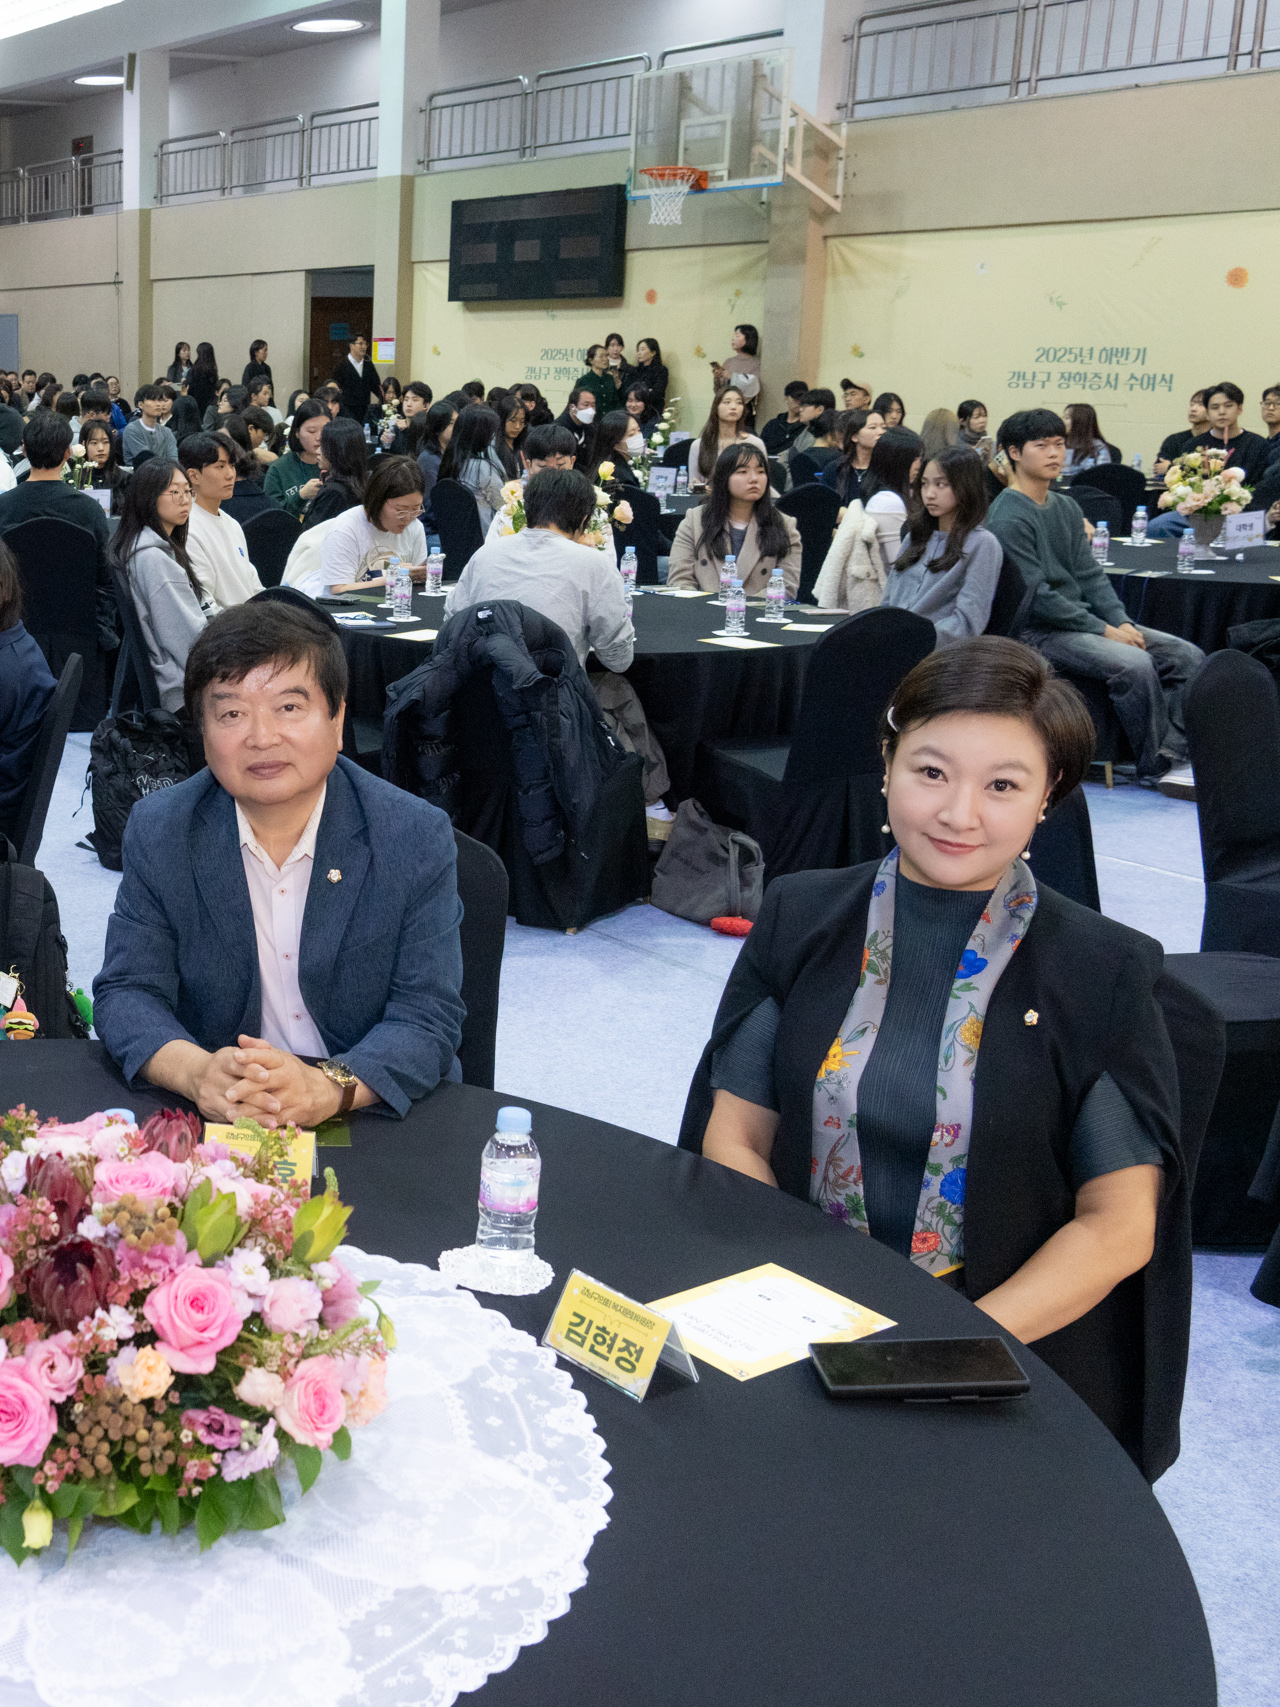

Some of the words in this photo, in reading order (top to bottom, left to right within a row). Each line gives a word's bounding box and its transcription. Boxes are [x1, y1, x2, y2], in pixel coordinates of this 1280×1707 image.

[541, 348, 574, 361] 2025년
[1035, 346, 1094, 365] 2025년
[1099, 346, 1146, 366] 하반기
[525, 367, 550, 380] 강남구
[1007, 371, 1051, 389] 강남구
[1057, 371, 1119, 390] 장학증서
[1124, 372, 1174, 392] 수여식
[580, 1286, 612, 1308] 강남구의회
[564, 1311, 644, 1374] 김현정
